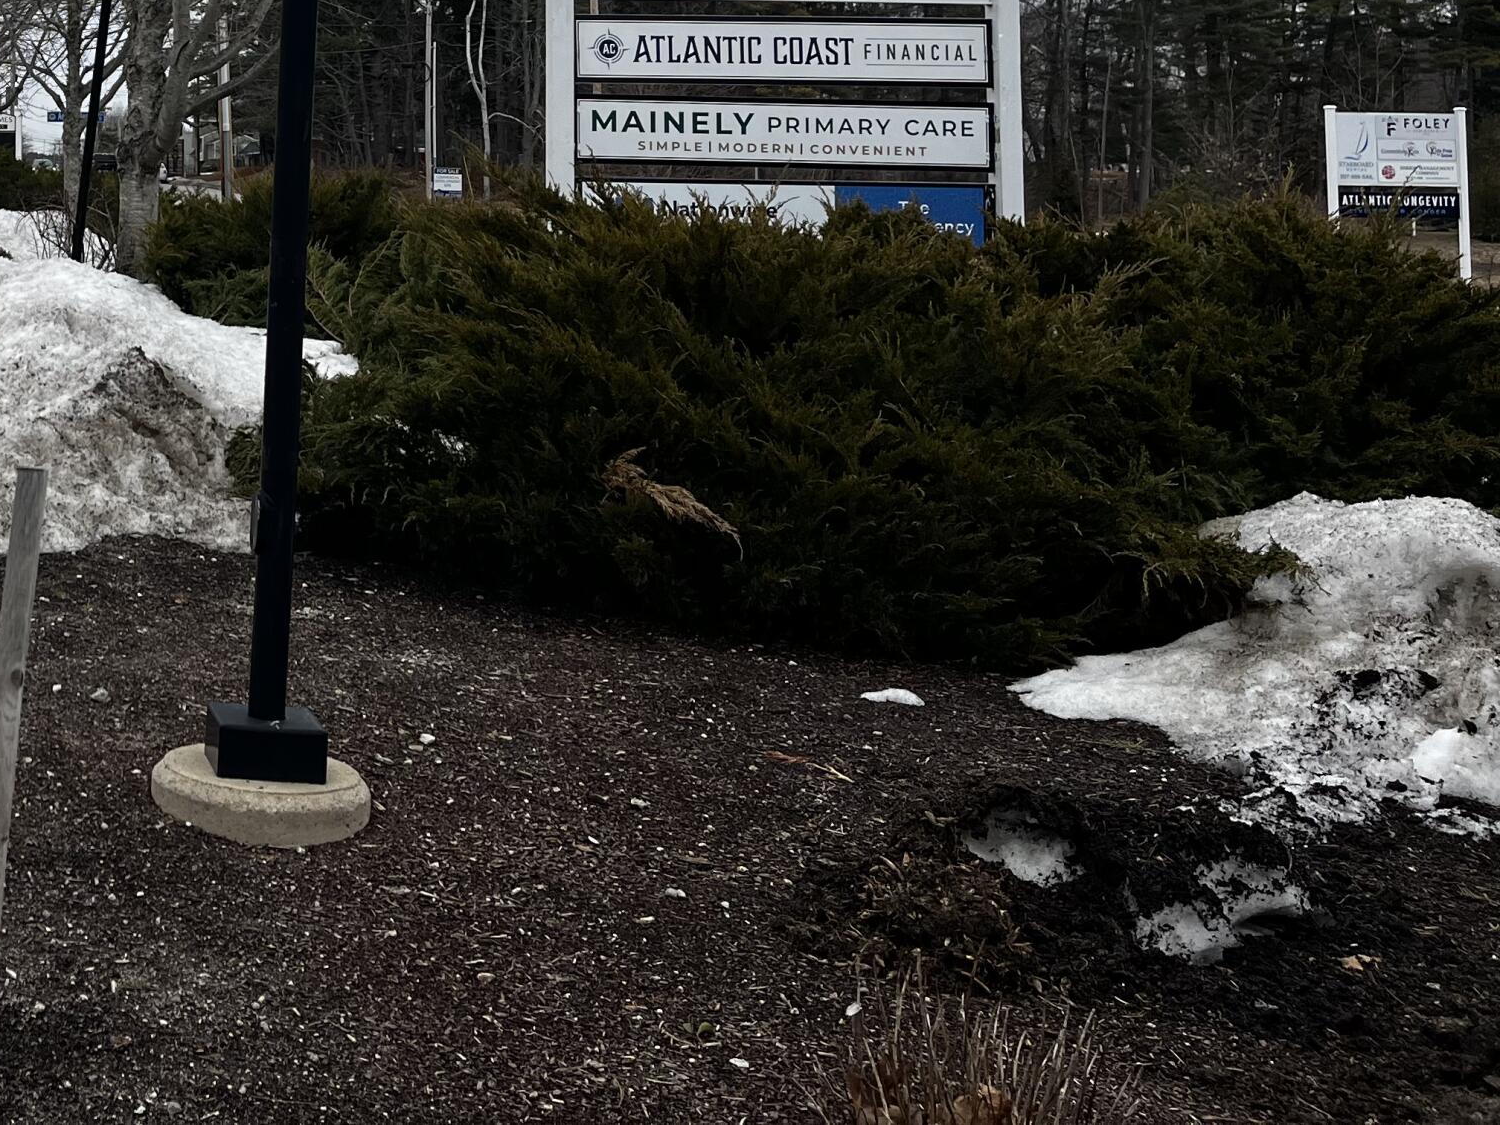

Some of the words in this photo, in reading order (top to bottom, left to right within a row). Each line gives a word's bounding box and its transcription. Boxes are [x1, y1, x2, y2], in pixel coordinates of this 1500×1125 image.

[602, 43, 616, 55] AC
[633, 34, 762, 65] ATLANTIC
[773, 36, 854, 66] COAST
[863, 43, 978, 62] FINANCIAL
[590, 110, 755, 136] MAINELY
[767, 117, 891, 136] PRIMARY
[905, 119, 975, 138] CARE
[1403, 118, 1450, 129] FOLEY
[637, 141, 703, 153] SIMPLE
[718, 142, 795, 155] MODERN
[809, 144, 928, 157] CONVENIENT
[898, 201, 930, 215] Te
[1398, 195, 1456, 207] ONGEVITY
[664, 200, 778, 219] Natonwie
